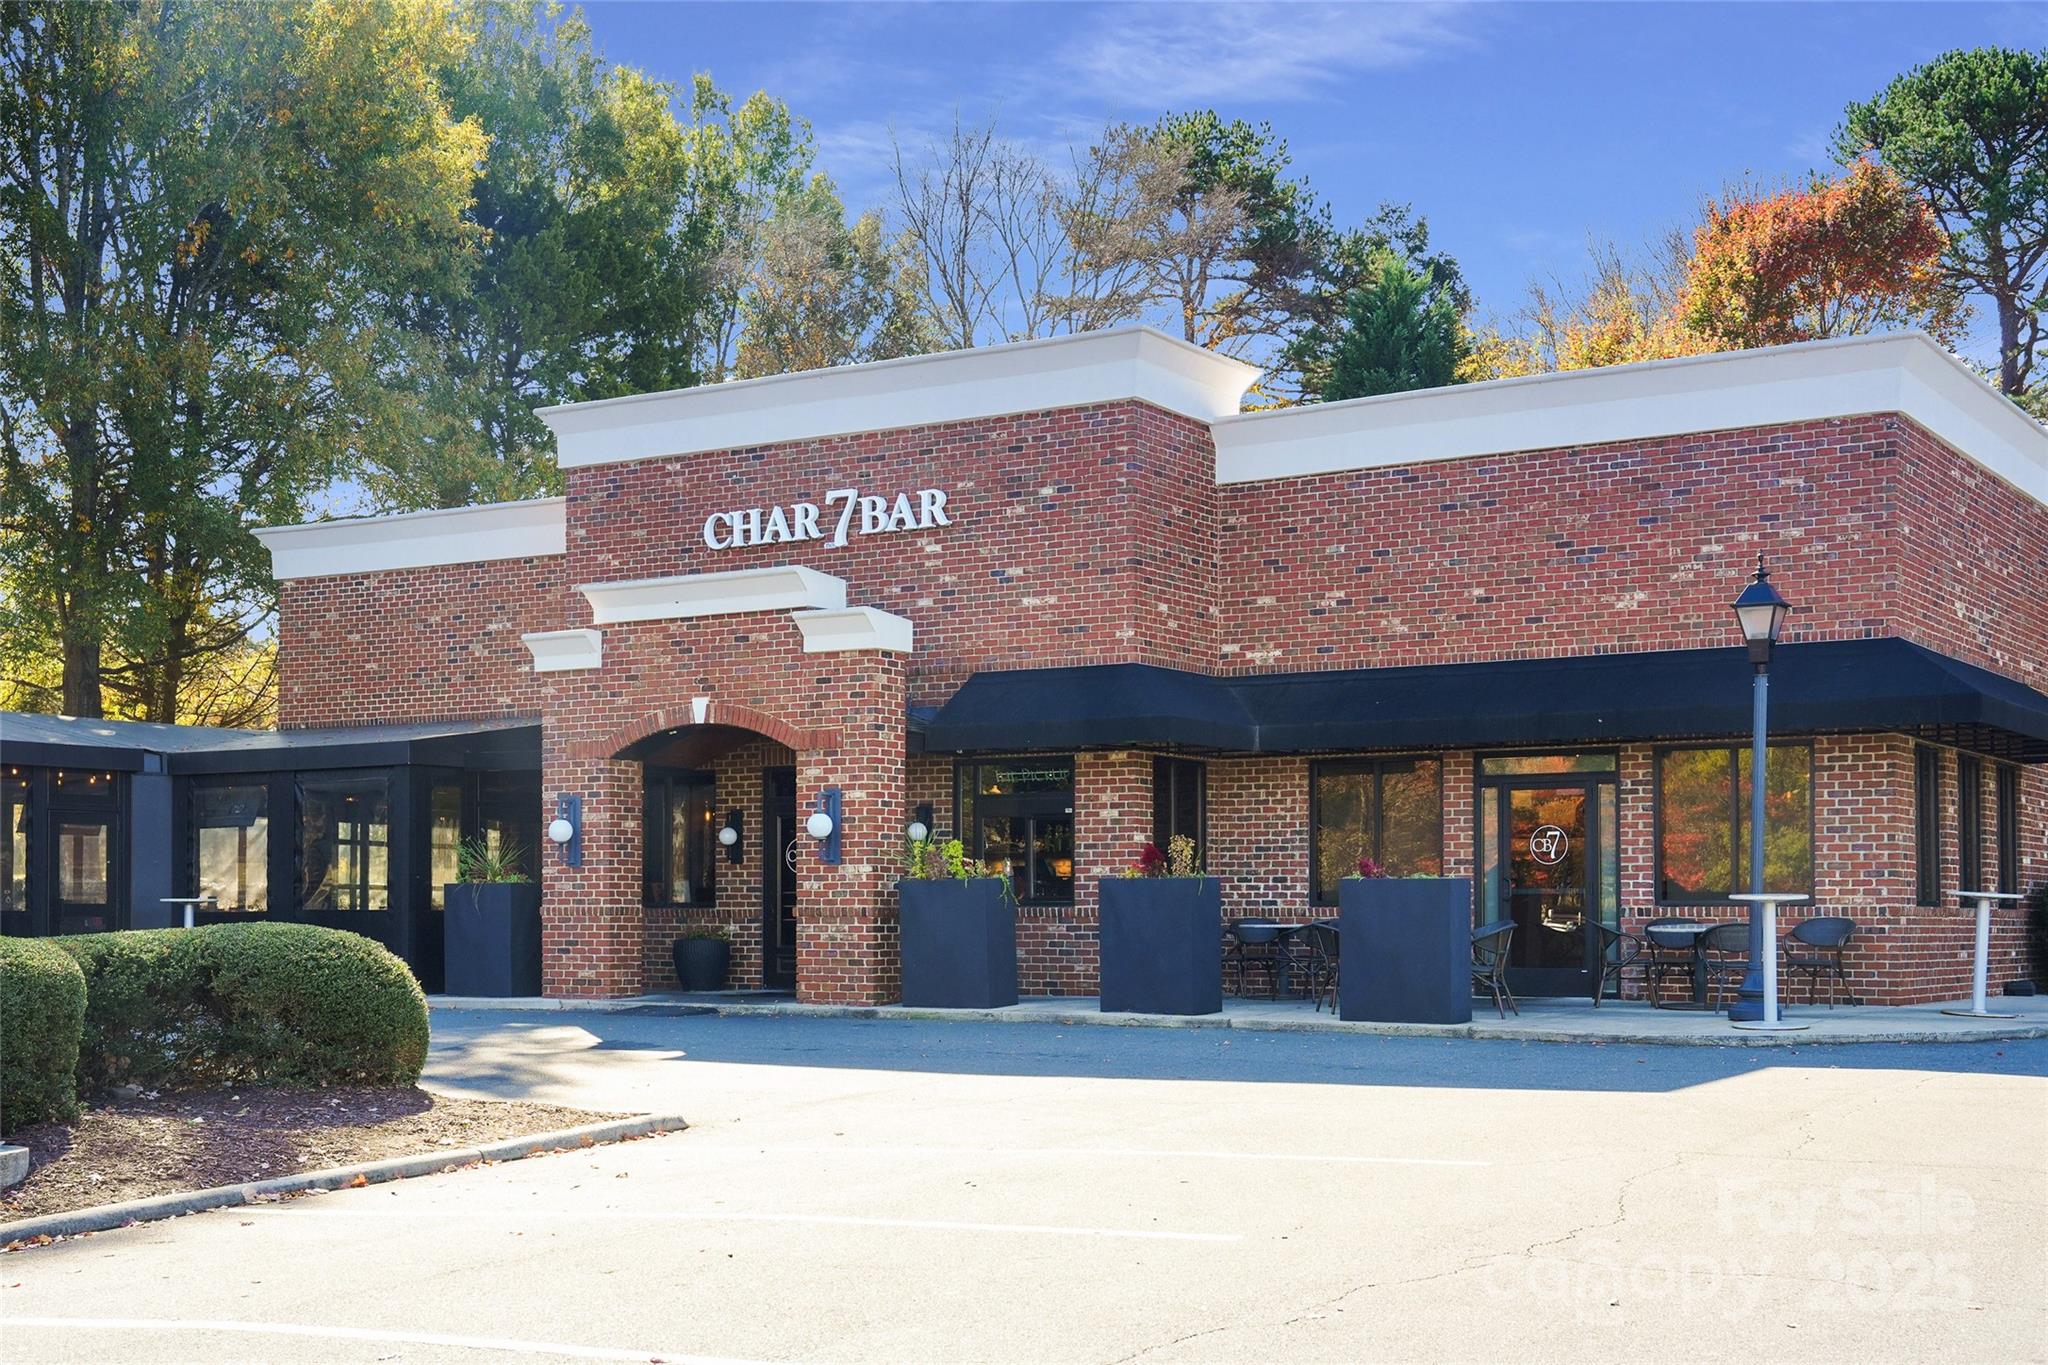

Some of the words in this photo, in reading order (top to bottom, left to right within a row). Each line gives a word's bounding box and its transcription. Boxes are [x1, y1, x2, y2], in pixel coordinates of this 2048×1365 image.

[703, 502, 824, 550] CHAR
[824, 488, 859, 548] 7
[857, 488, 952, 535] BAR
